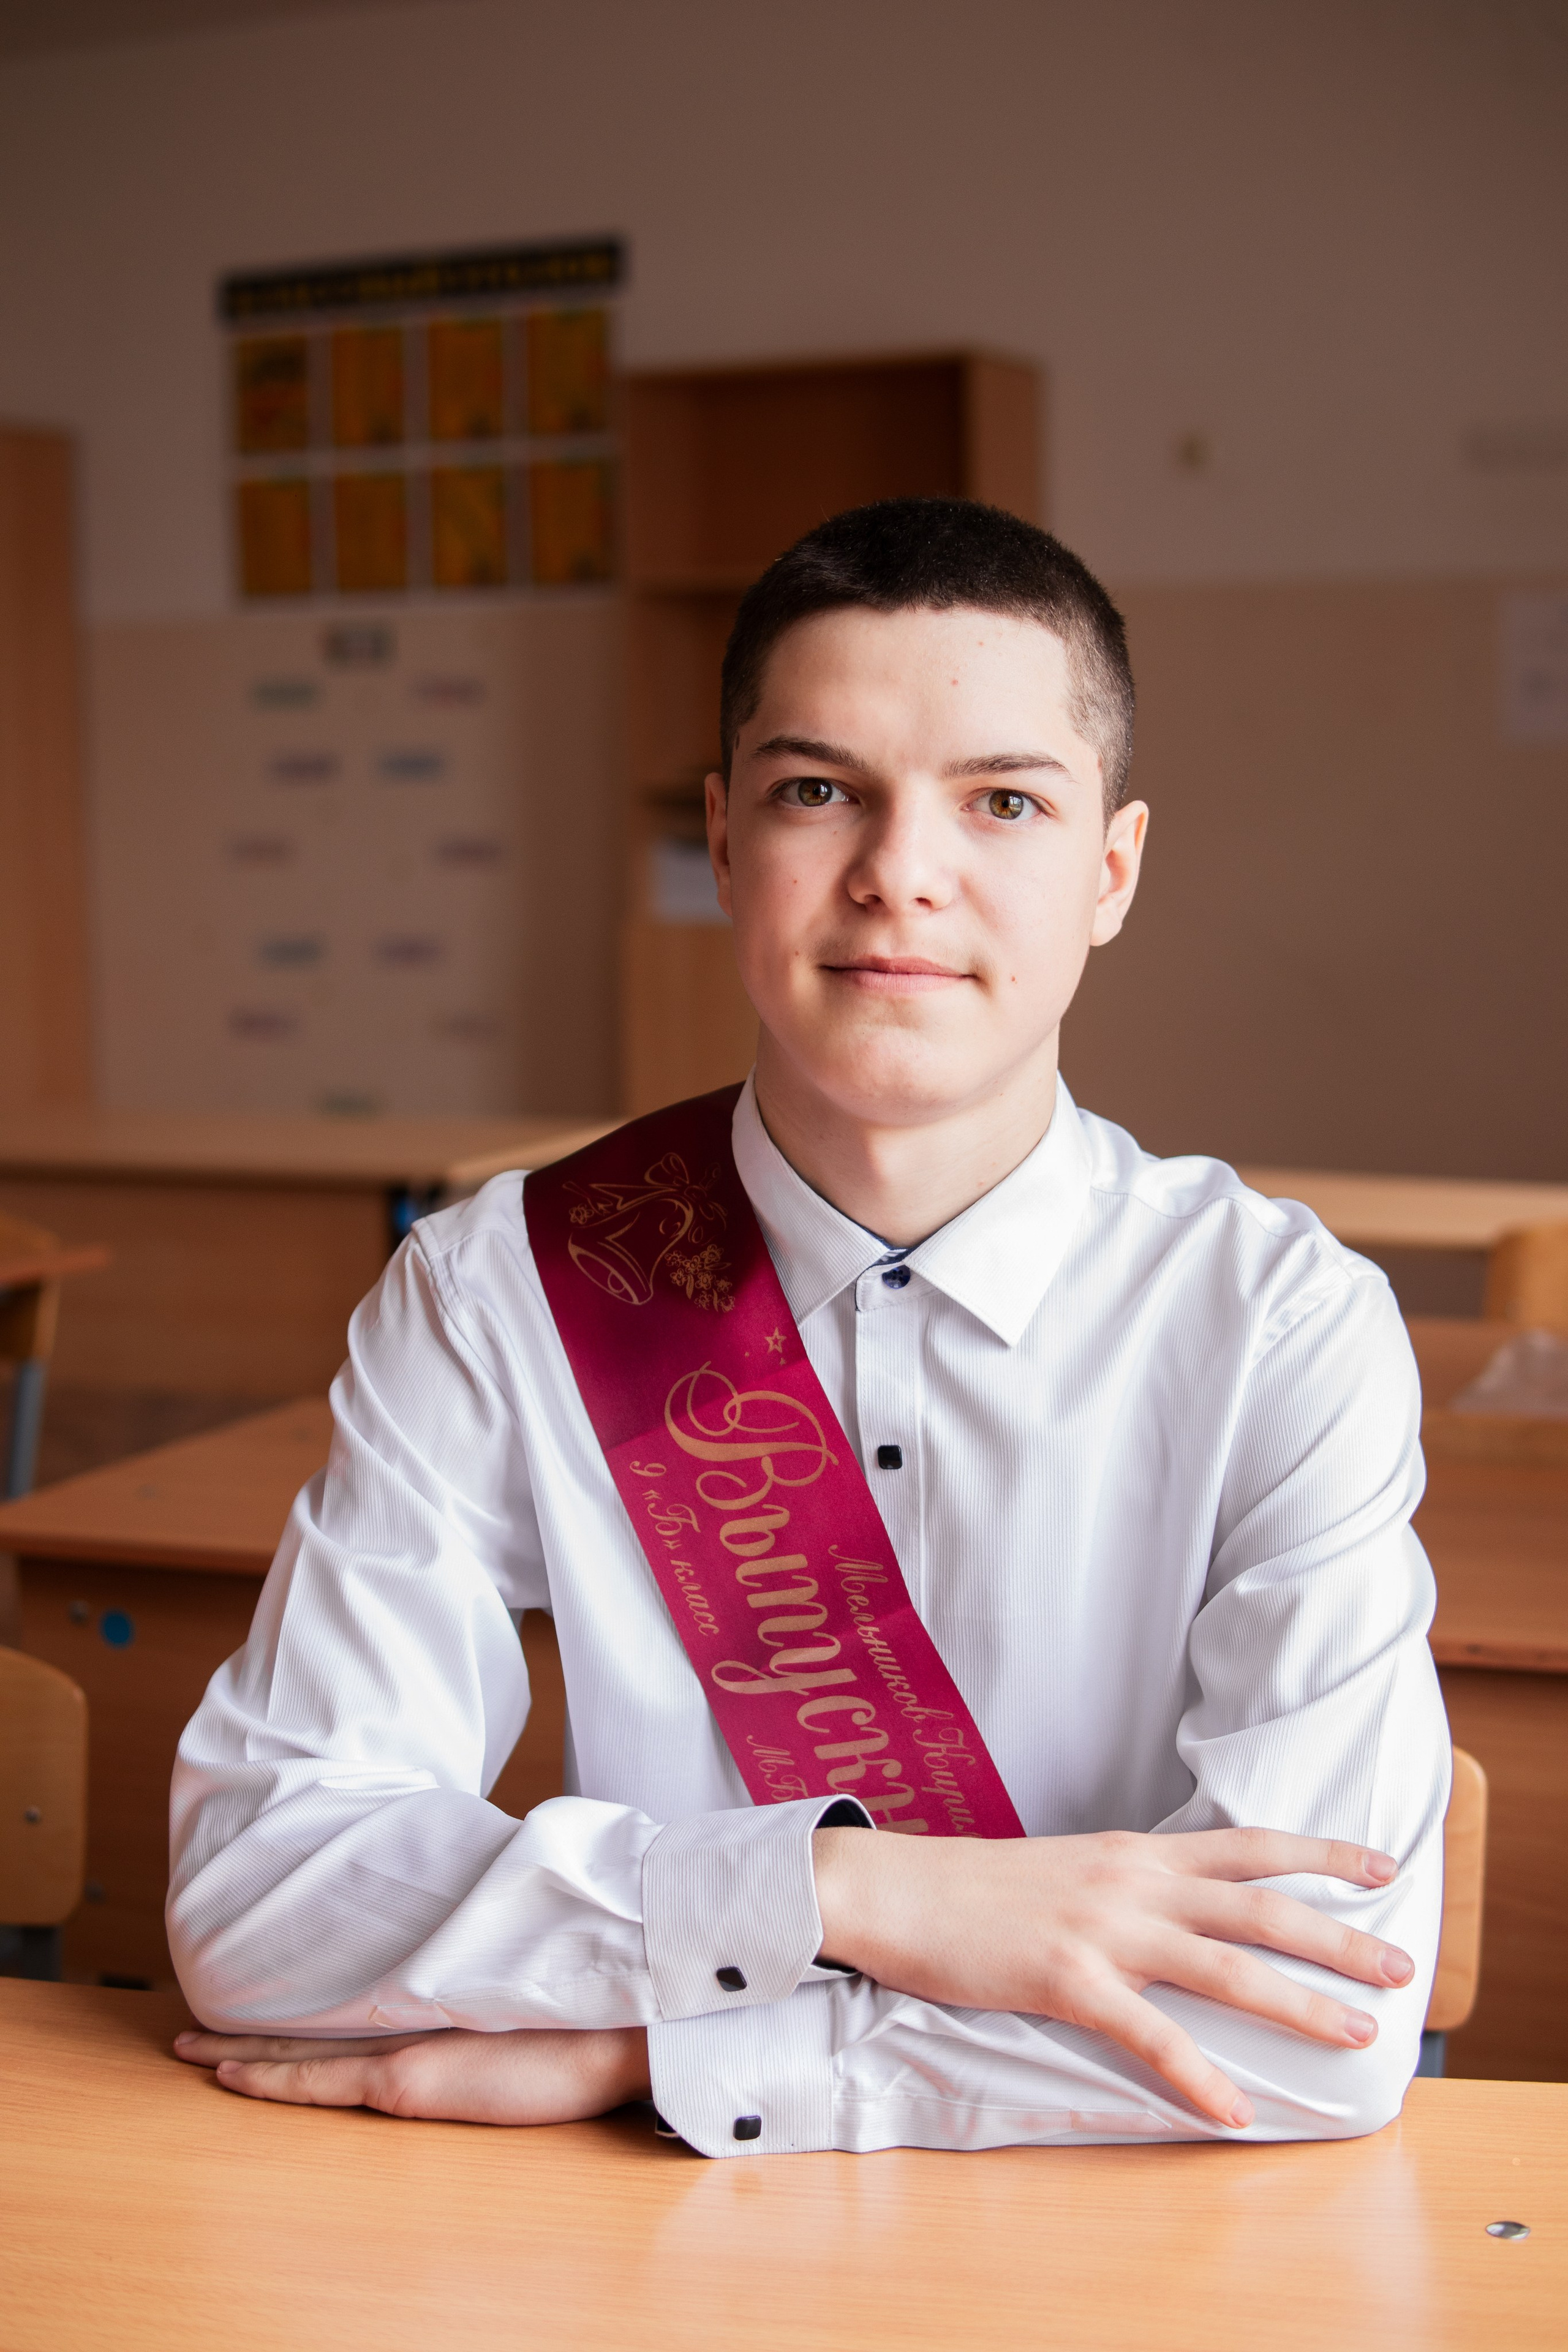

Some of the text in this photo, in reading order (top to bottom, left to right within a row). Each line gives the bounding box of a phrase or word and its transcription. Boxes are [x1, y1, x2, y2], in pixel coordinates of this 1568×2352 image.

[630, 1461, 666, 1477] 9
[670, 1559, 720, 1637] класс
[828, 1544, 954, 1722] Мельников
